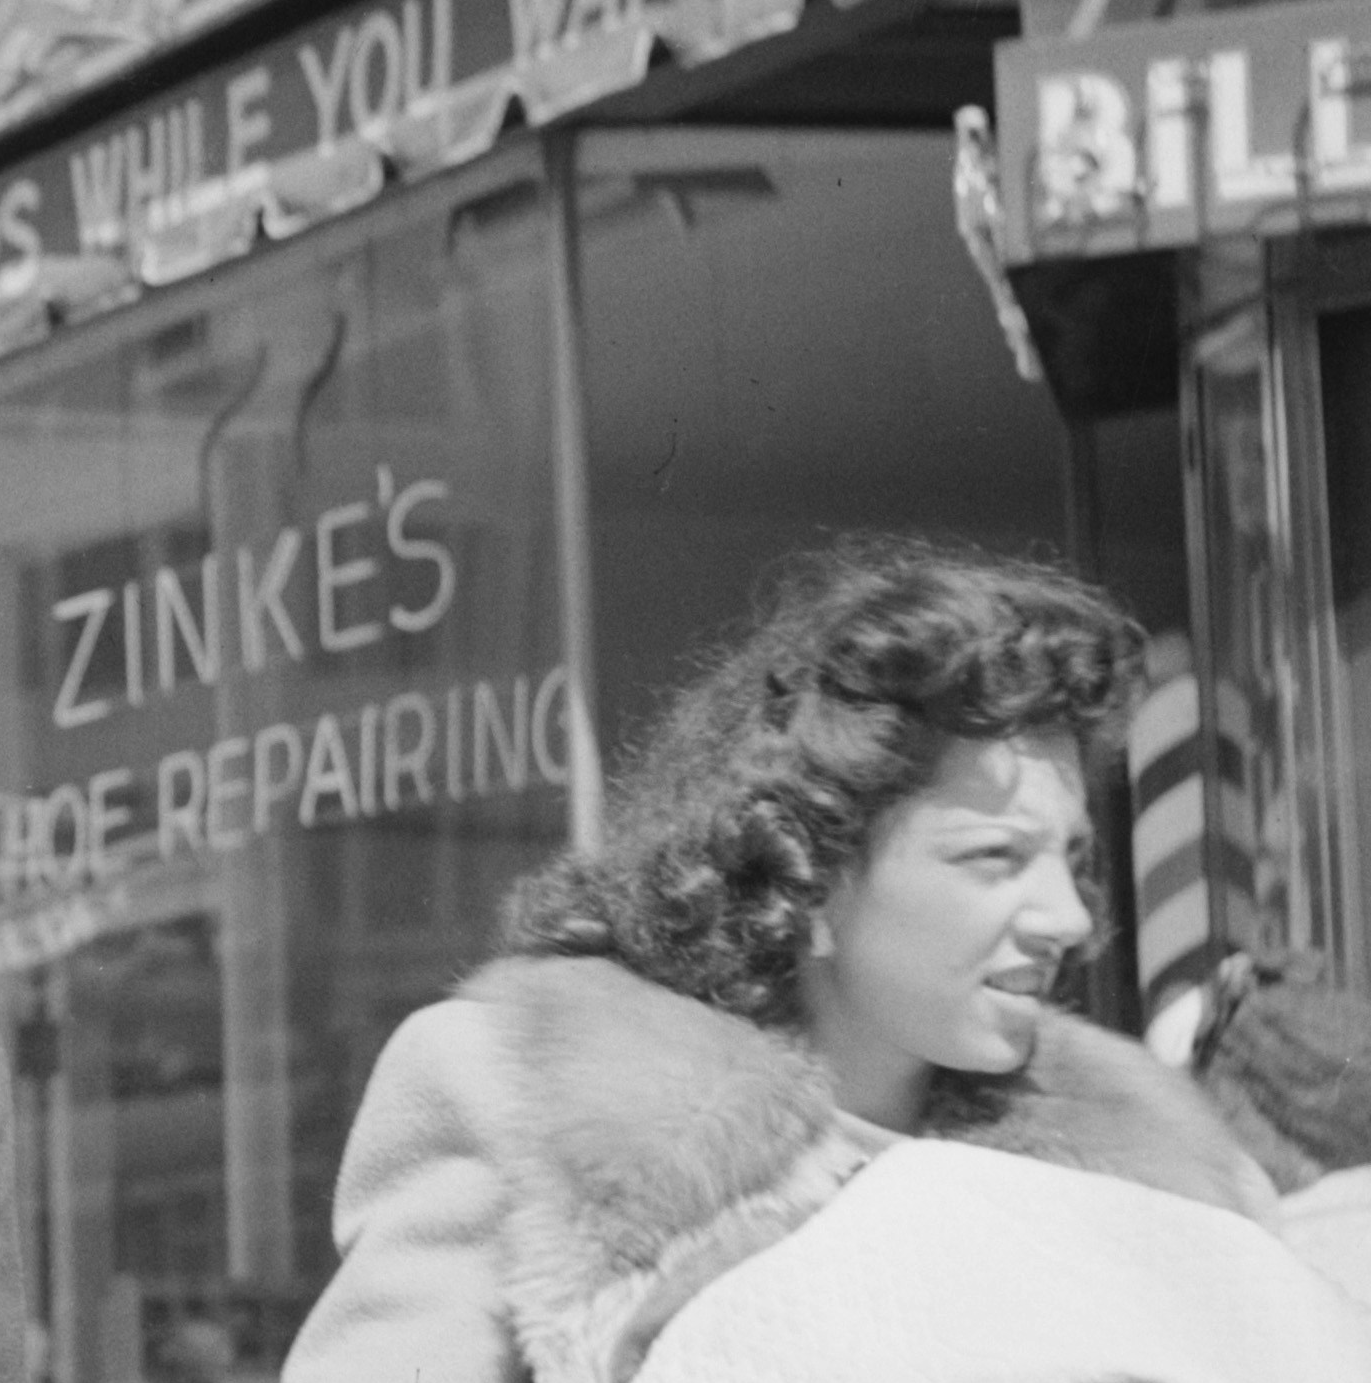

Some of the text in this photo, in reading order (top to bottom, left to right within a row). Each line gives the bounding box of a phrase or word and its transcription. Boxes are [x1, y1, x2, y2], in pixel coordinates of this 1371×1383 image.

[69, 64, 274, 262] WHILE
[52, 462, 457, 729] ZINKE'S
[156, 665, 575, 859] REPAIRING
